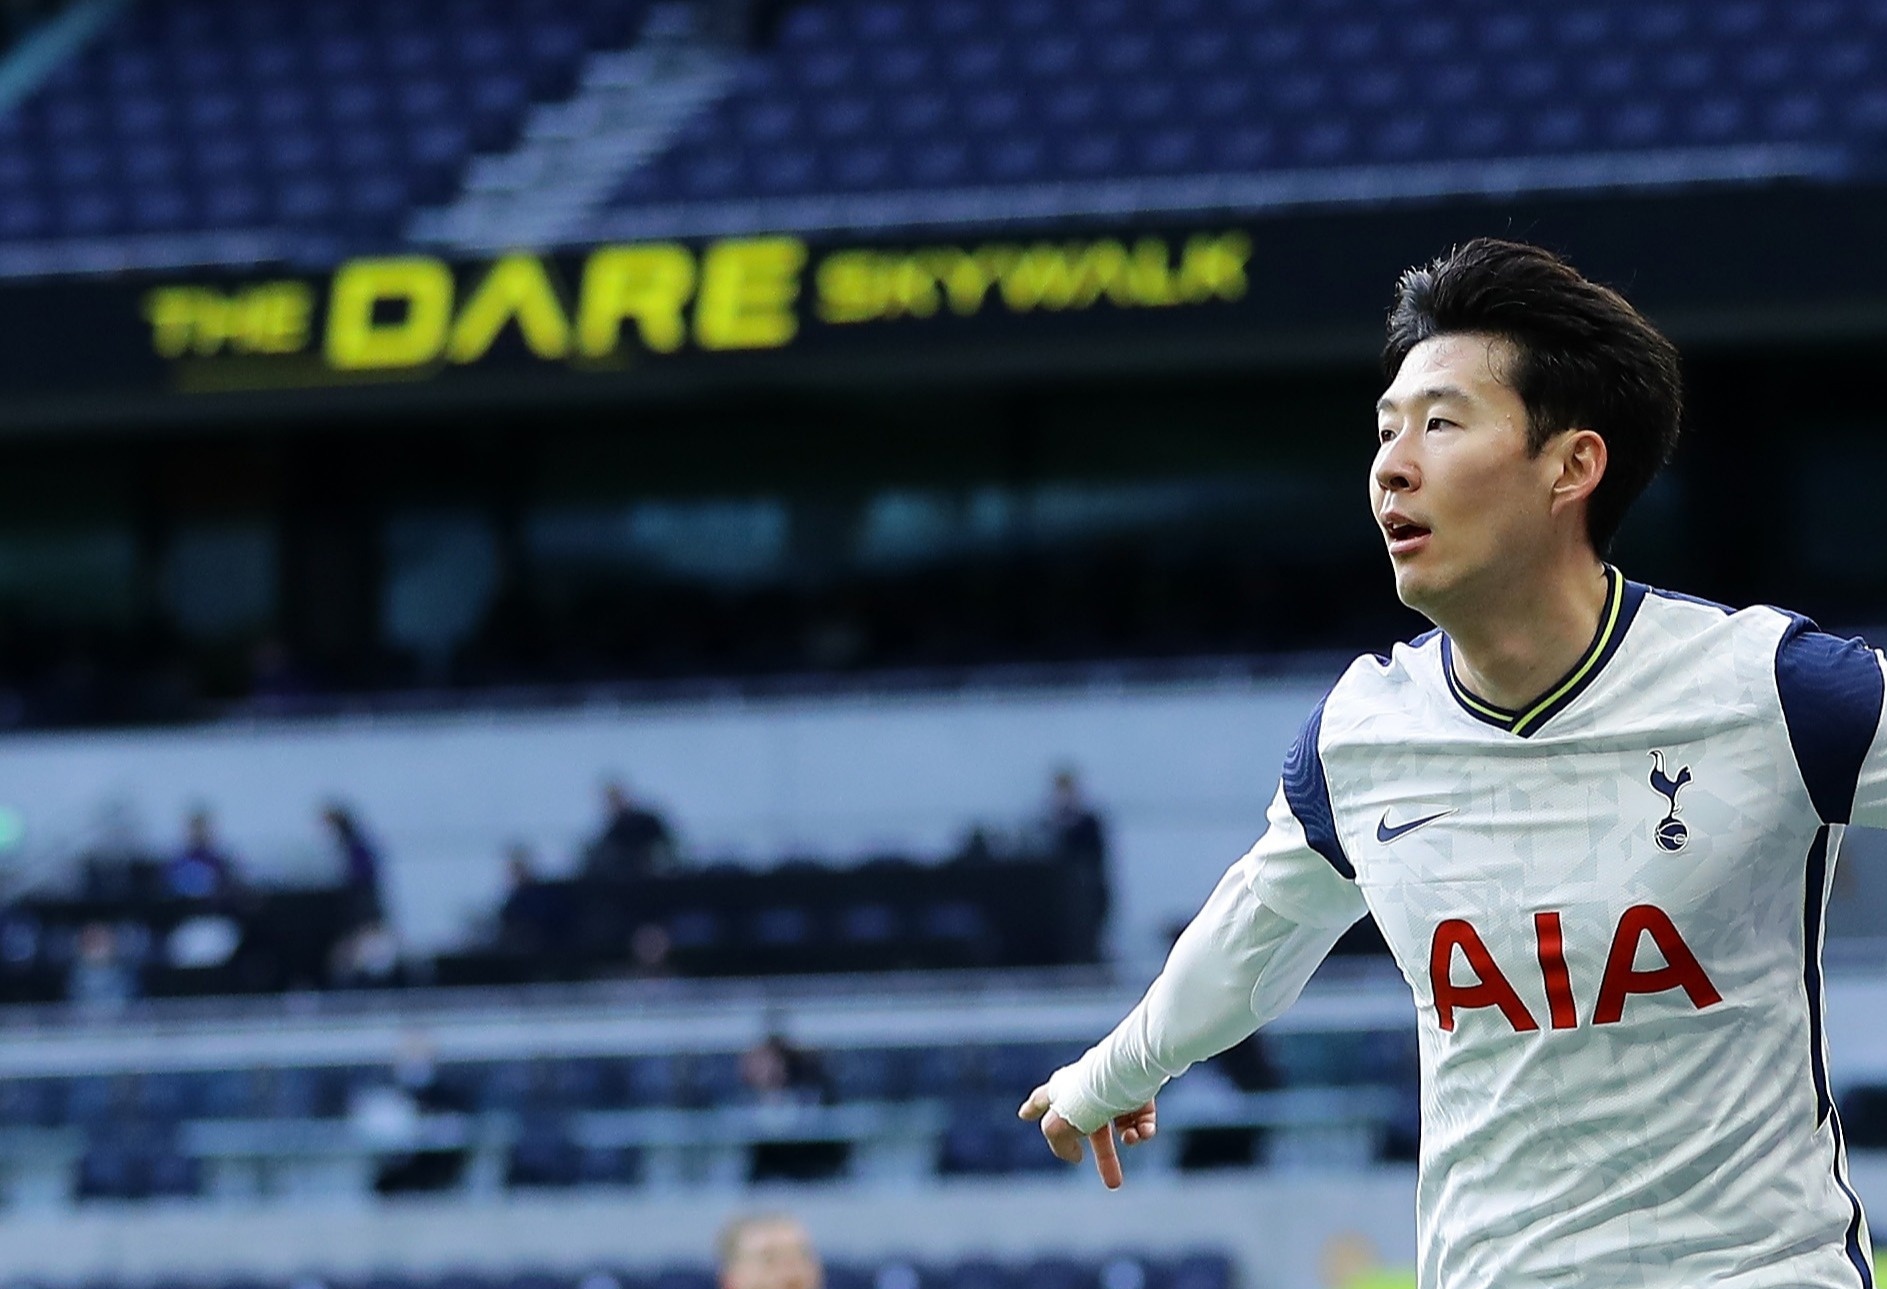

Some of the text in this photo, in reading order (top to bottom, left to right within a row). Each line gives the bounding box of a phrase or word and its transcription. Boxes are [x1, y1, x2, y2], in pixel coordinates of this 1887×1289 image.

[146, 234, 1252, 371] THE DARE SKYWALK
[1428, 904, 1724, 1032] AIA
